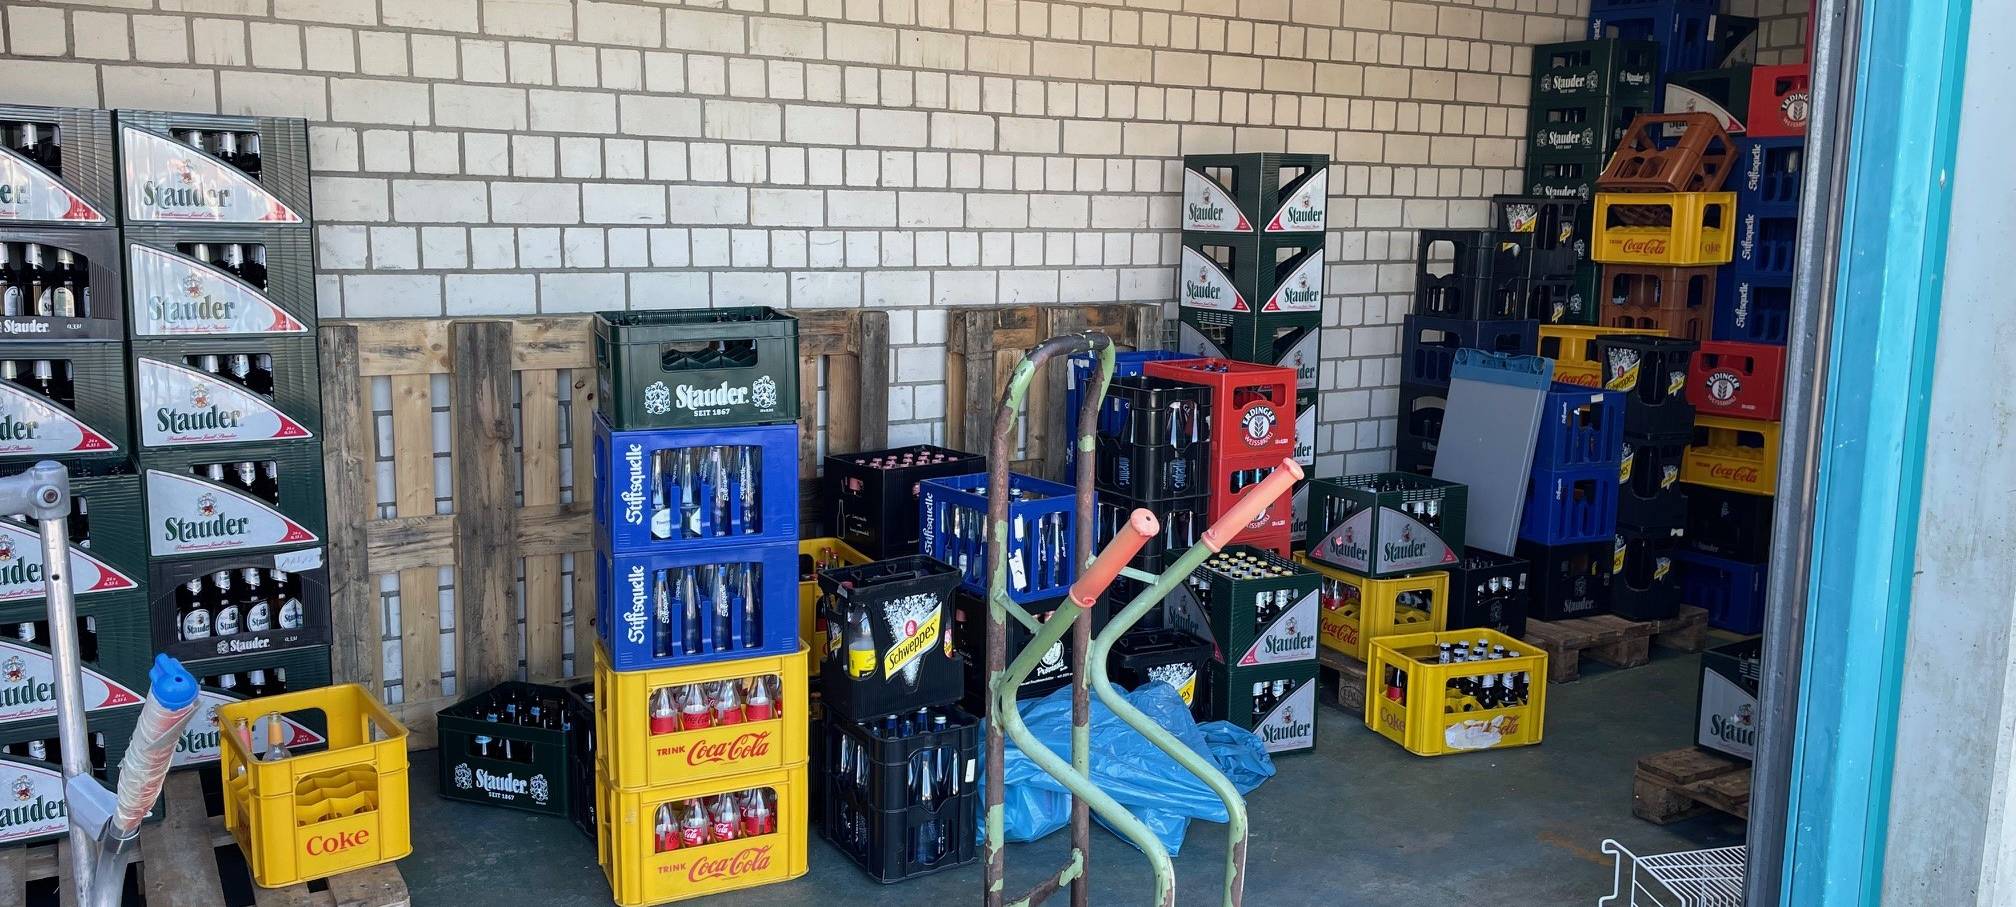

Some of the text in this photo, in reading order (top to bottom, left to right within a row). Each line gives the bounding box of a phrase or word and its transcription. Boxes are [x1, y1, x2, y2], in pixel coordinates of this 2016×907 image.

[1553, 74, 1585, 90] Stauder
[1782, 92, 1808, 111] ERDING
[1549, 131, 1580, 146] Stauder
[143, 179, 230, 210] Stauder
[1189, 202, 1223, 222] Stauder
[1287, 206, 1322, 224] Stauder
[1186, 279, 1220, 300] Stauder
[1284, 287, 1319, 304] Stauder
[150, 295, 235, 324] Stauder
[4, 318, 48, 334] Stauder
[157, 404, 240, 434] Stauder
[694, 408, 730, 417] SEIT 1867
[1242, 406, 1275, 425] ERDINGER
[621, 443, 646, 525] Stiftsquelle
[165, 511, 250, 543] Stauder
[1330, 536, 1367, 561] Stauder
[1383, 539, 1425, 562] Stauder
[623, 565, 648, 644] Stiftsquelle
[889, 621, 935, 671] Schweppes
[1265, 632, 1314, 654] Stauder
[1262, 722, 1311, 744] Stauder
[1711, 714, 1755, 746] Staud
[657, 731, 772, 767] TRINK Coca-Cola
[0, 795, 66, 831] auder
[306, 829, 369, 856] Coke
[657, 843, 774, 883] TRINK Coca-Cola
